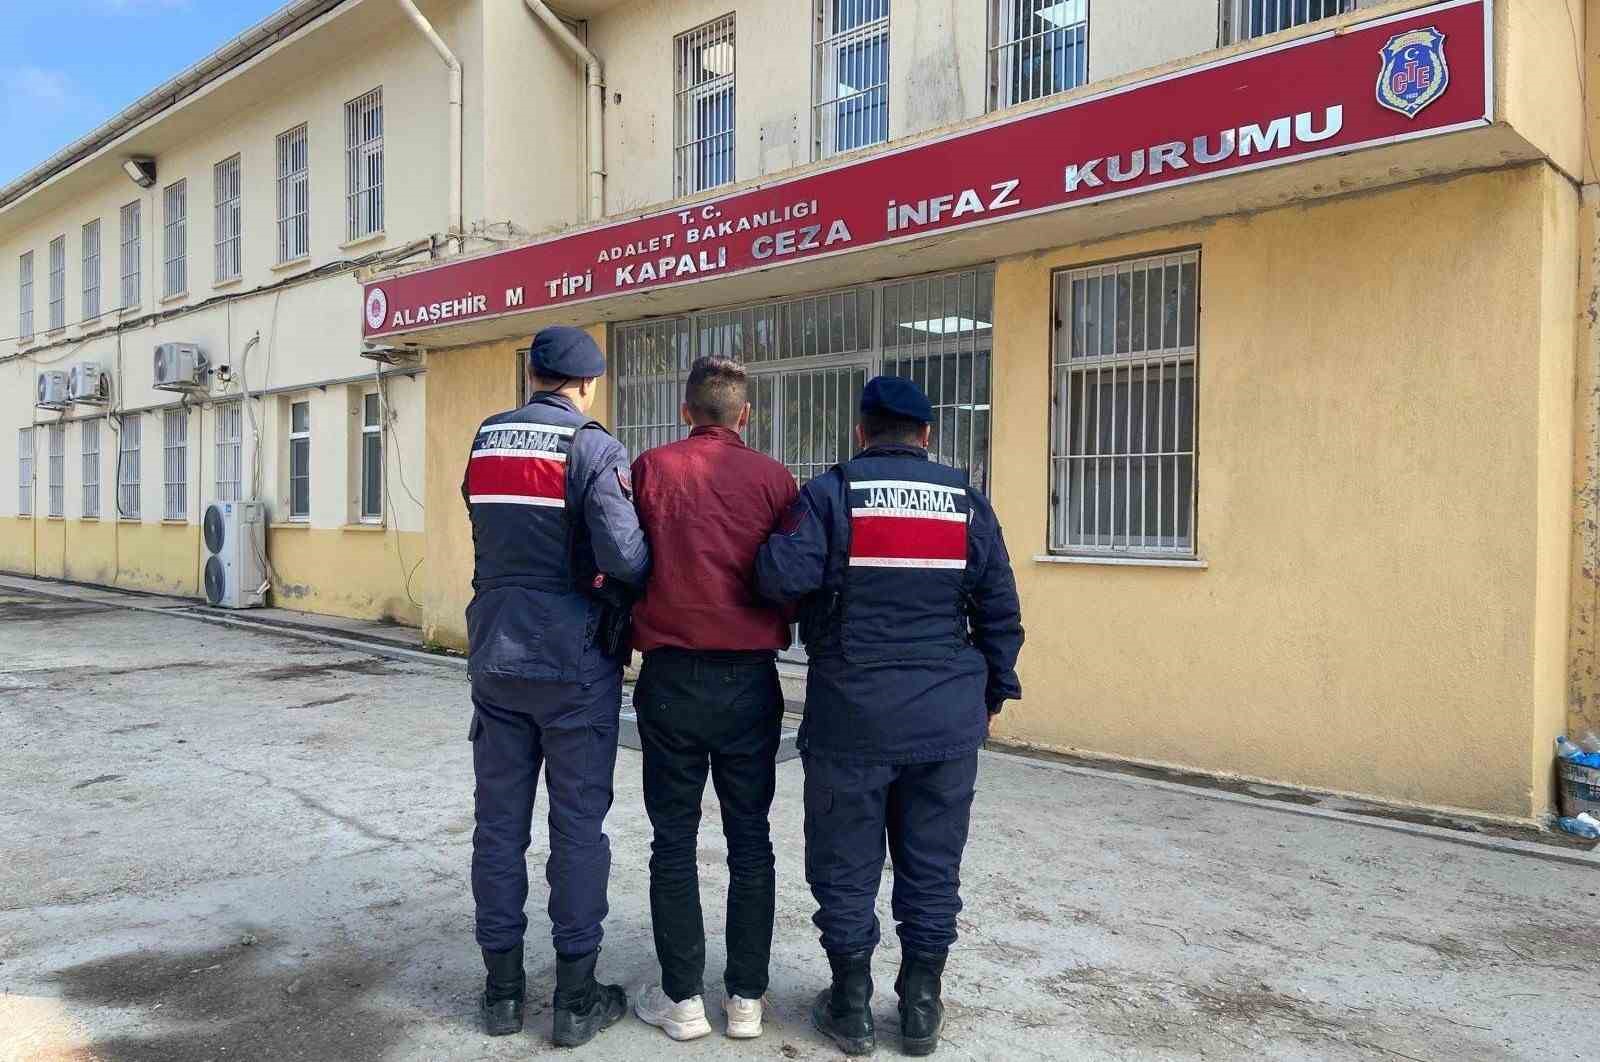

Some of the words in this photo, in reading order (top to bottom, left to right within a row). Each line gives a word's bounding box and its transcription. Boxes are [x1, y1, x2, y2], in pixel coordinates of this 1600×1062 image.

[392, 292, 487, 328] ALAŞEHİR
[505, 287, 524, 307] M
[545, 270, 592, 298] TİPİ
[615, 246, 726, 286] KAPALI
[752, 219, 852, 259] CEZA
[887, 178, 1020, 232] İNFAZ
[1065, 104, 1343, 192] KURUMU
[678, 210, 695, 225] T.
[702, 205, 722, 220] C.
[597, 233, 675, 263] ADALET
[481, 430, 559, 452] JANDARMA
[864, 487, 956, 512] JANDARMA
